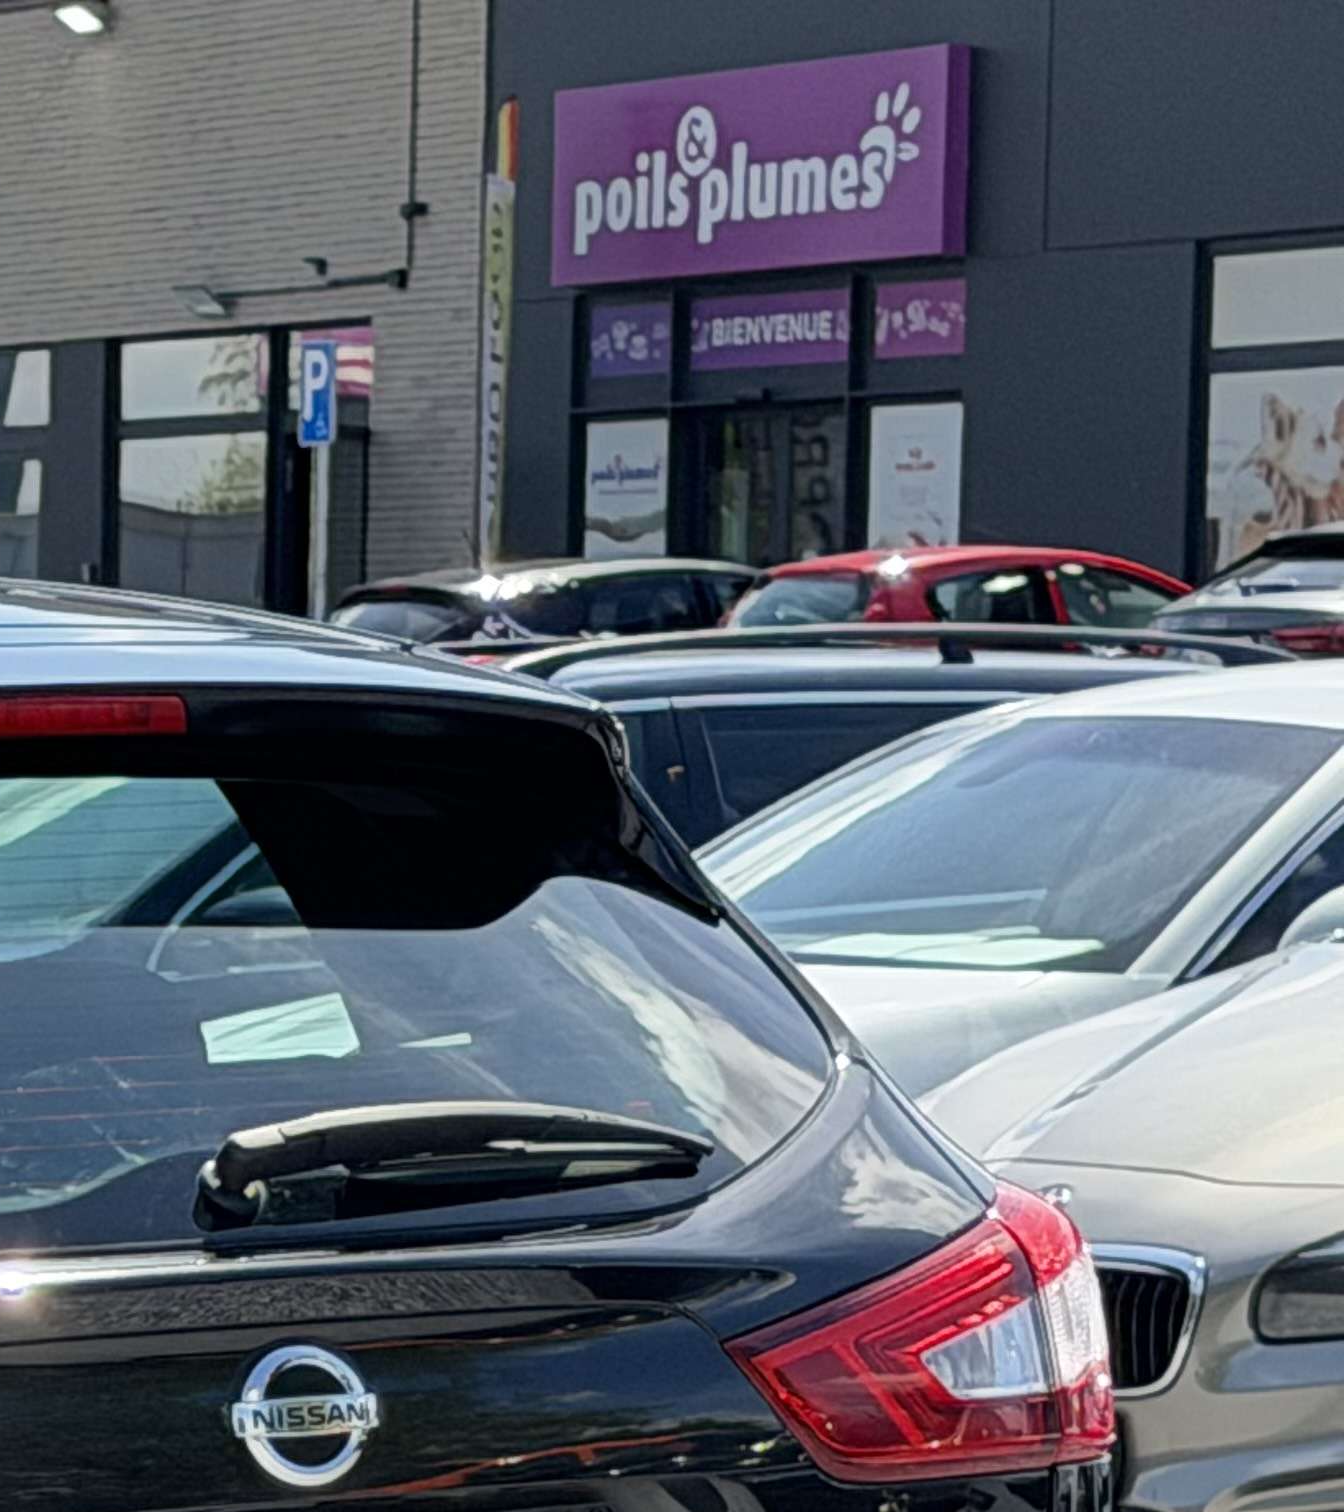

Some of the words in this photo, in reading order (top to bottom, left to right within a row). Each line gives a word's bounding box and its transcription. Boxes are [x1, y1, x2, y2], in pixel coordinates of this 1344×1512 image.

[574, 149, 689, 255] poils
[698, 141, 885, 244] plumes
[711, 310, 833, 347] BIENVENUE
[303, 349, 328, 423] P
[252, 1401, 370, 1432] NISSAN
